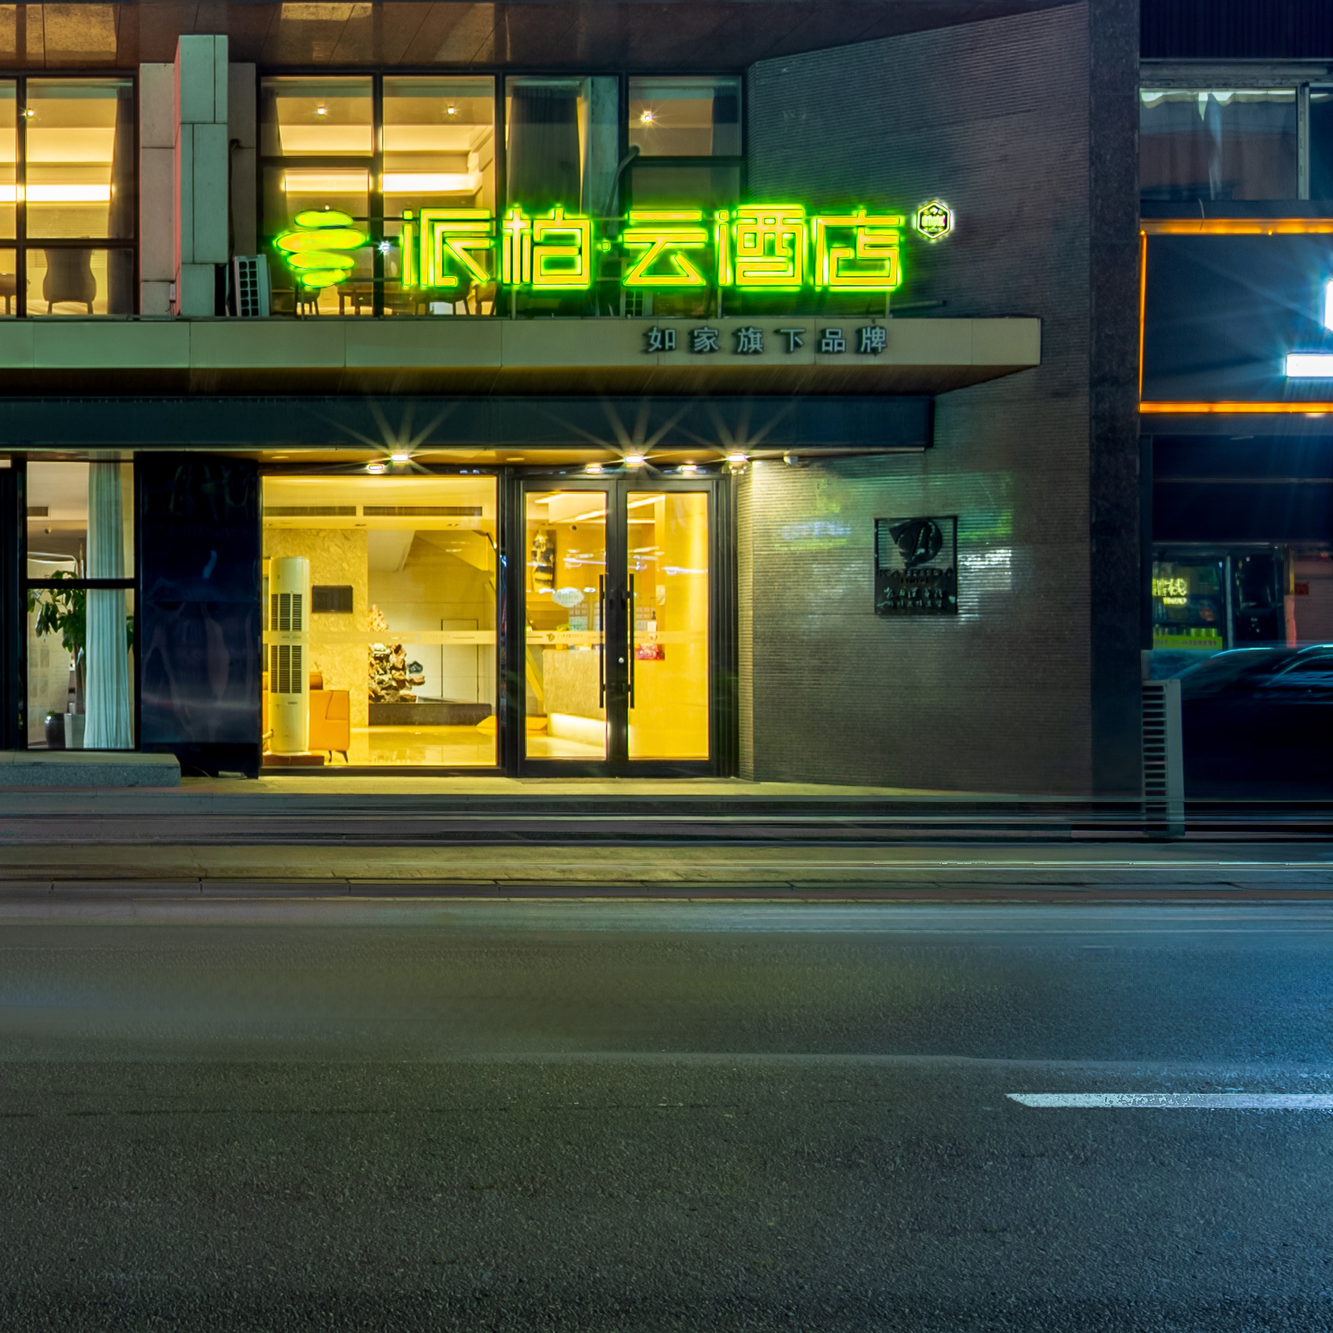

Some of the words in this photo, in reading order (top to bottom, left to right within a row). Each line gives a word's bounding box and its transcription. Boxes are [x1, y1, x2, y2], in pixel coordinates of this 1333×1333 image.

[647, 326, 888, 354] 如家旗下品牌
